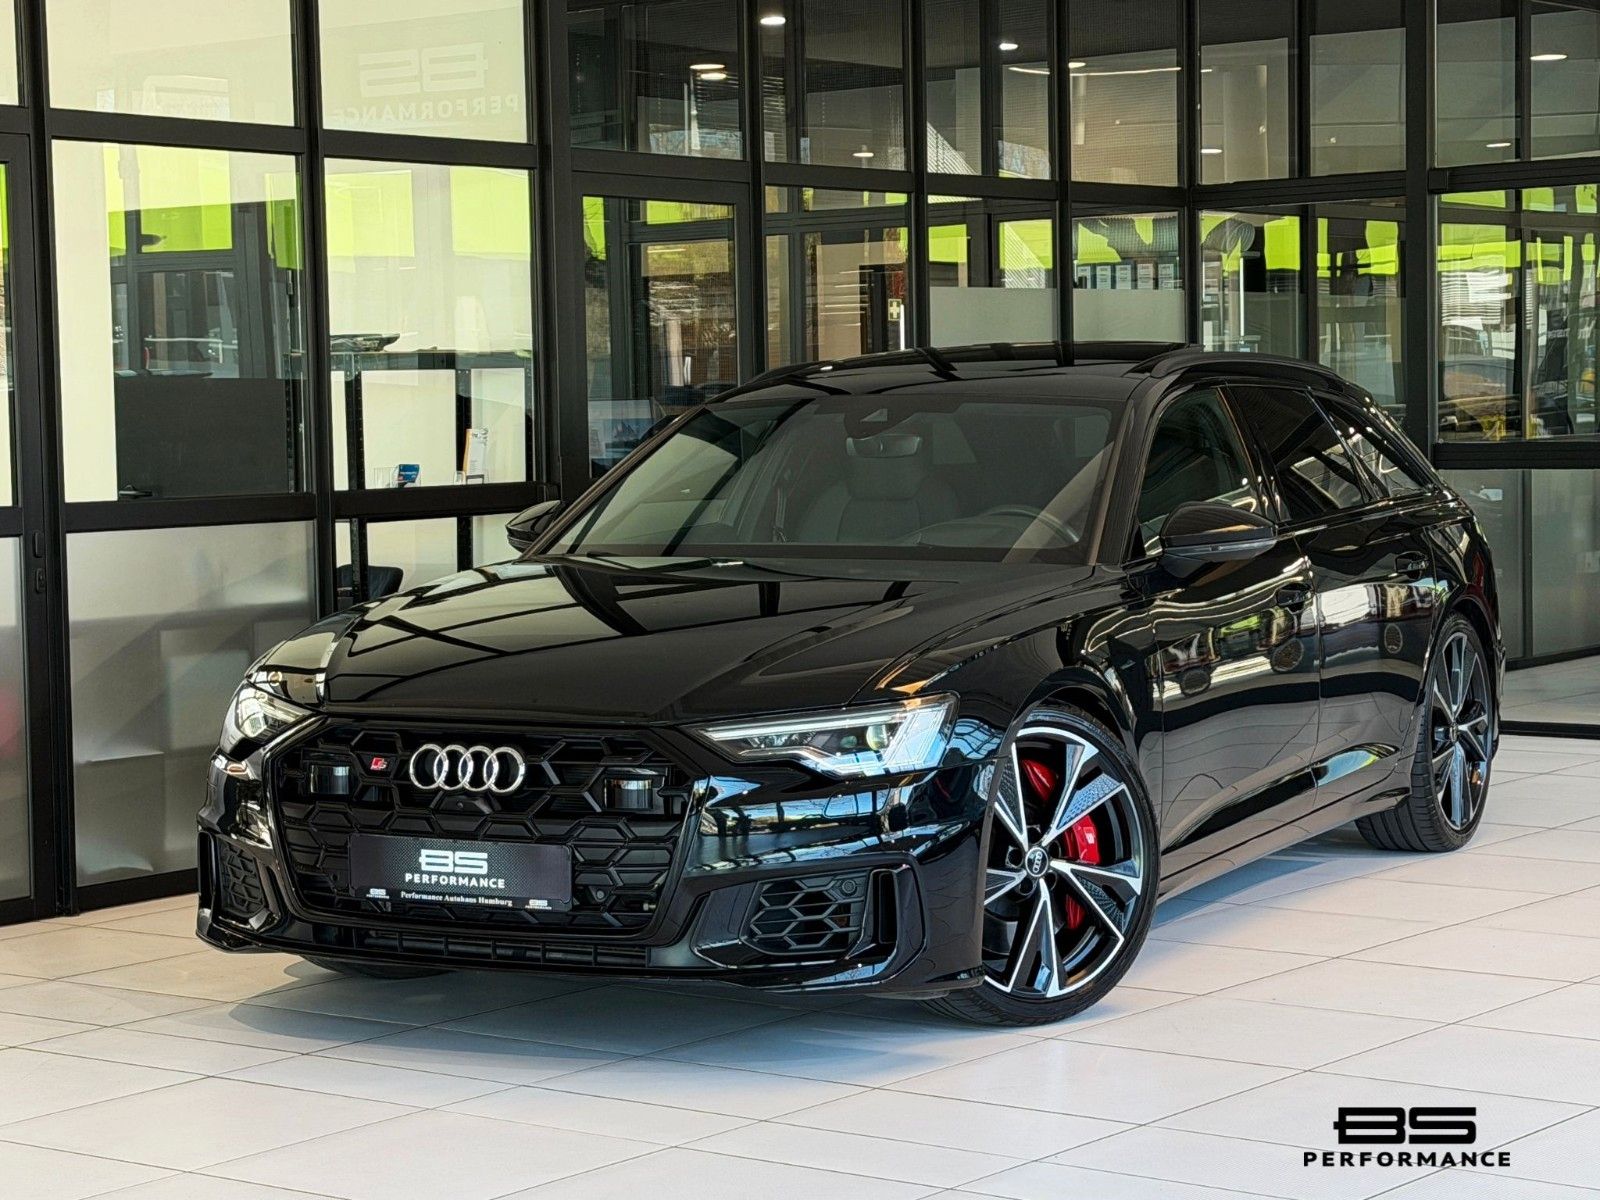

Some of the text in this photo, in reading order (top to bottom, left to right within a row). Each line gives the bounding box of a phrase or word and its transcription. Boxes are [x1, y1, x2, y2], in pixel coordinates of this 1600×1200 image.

[419, 849, 488, 874] BS
[405, 873, 505, 889] PERFORMANCE
[400, 891, 443, 901] Performance
[444, 895, 477, 904] Autohaus
